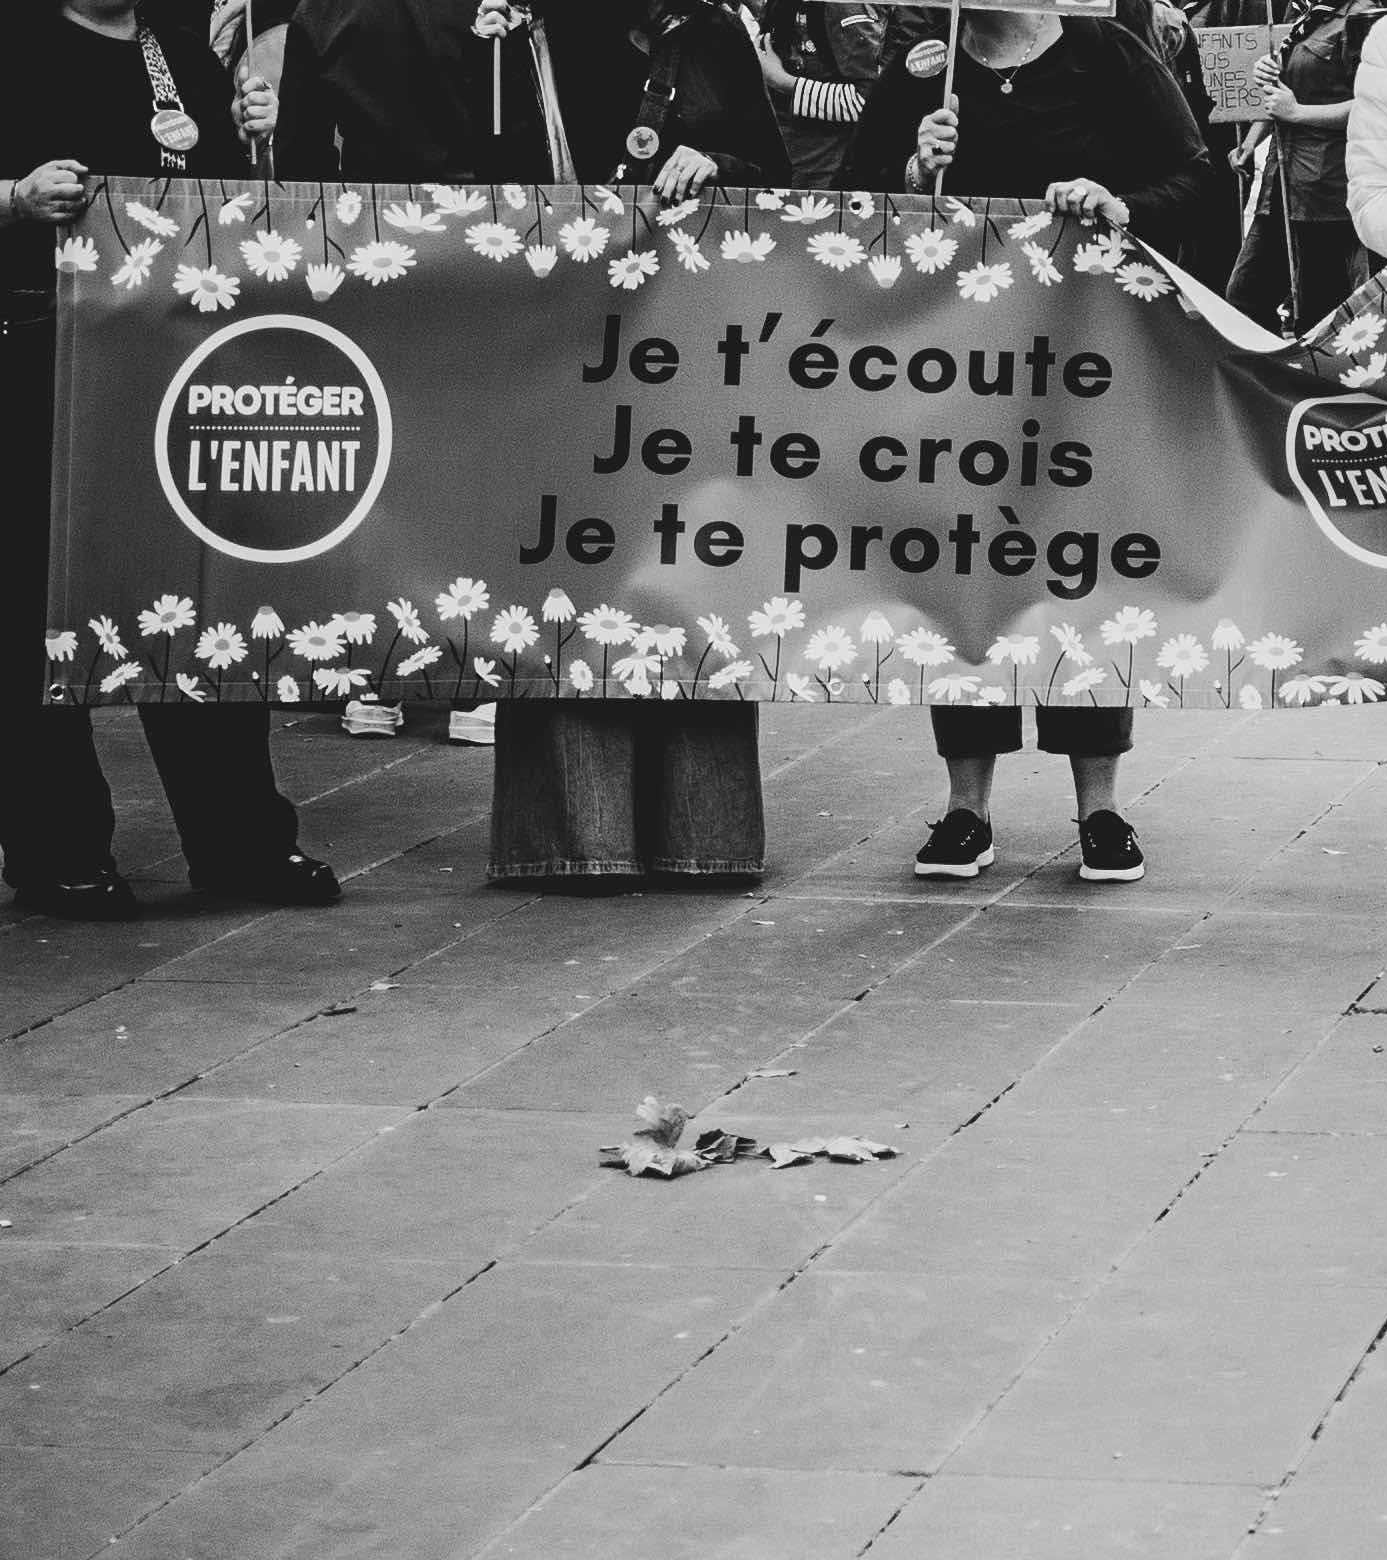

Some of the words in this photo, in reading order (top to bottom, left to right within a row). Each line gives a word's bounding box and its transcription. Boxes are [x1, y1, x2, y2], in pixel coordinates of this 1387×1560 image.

[188, 376, 365, 417] PROTÉGER
[582, 314, 680, 385] Je
[718, 312, 1114, 399] t'écoute
[188, 439, 361, 493] L'ENFANT
[593, 404, 691, 476] Je
[730, 415, 821, 479] te
[858, 419, 1094, 488] crois
[519, 494, 616, 565] Je
[653, 504, 744, 567] te
[784, 505, 1162, 600] protège
